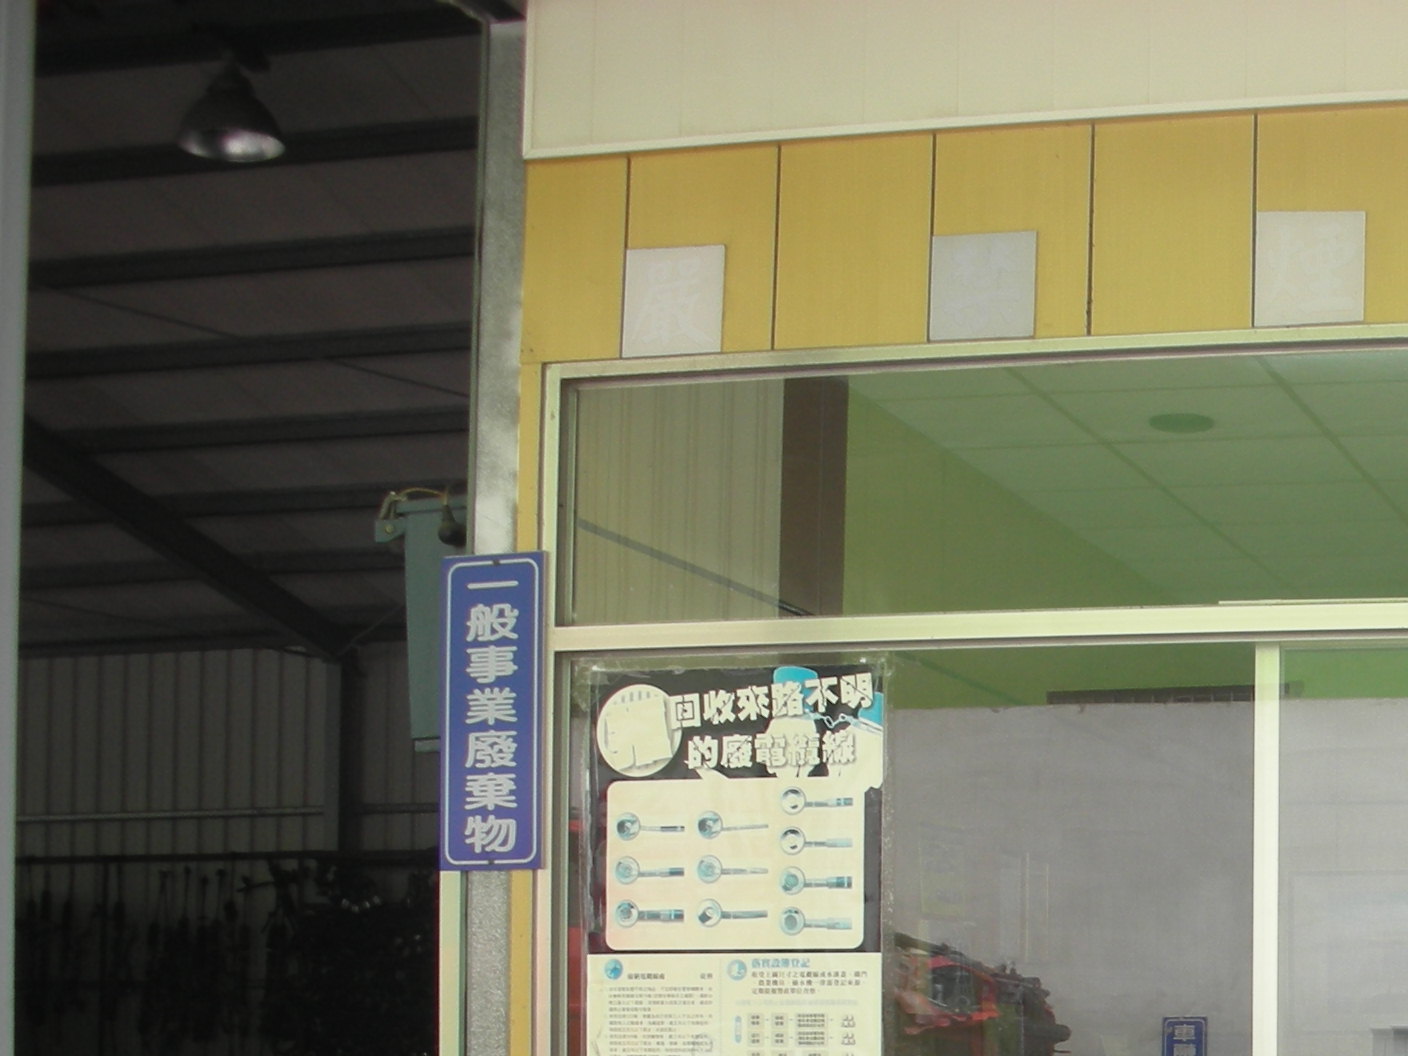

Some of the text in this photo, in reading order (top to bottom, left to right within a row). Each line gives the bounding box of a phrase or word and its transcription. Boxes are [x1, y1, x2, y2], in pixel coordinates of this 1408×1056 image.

[464, 580, 519, 854] 一般事業廢棄物
[668, 672, 874, 730] 回收來路不明
